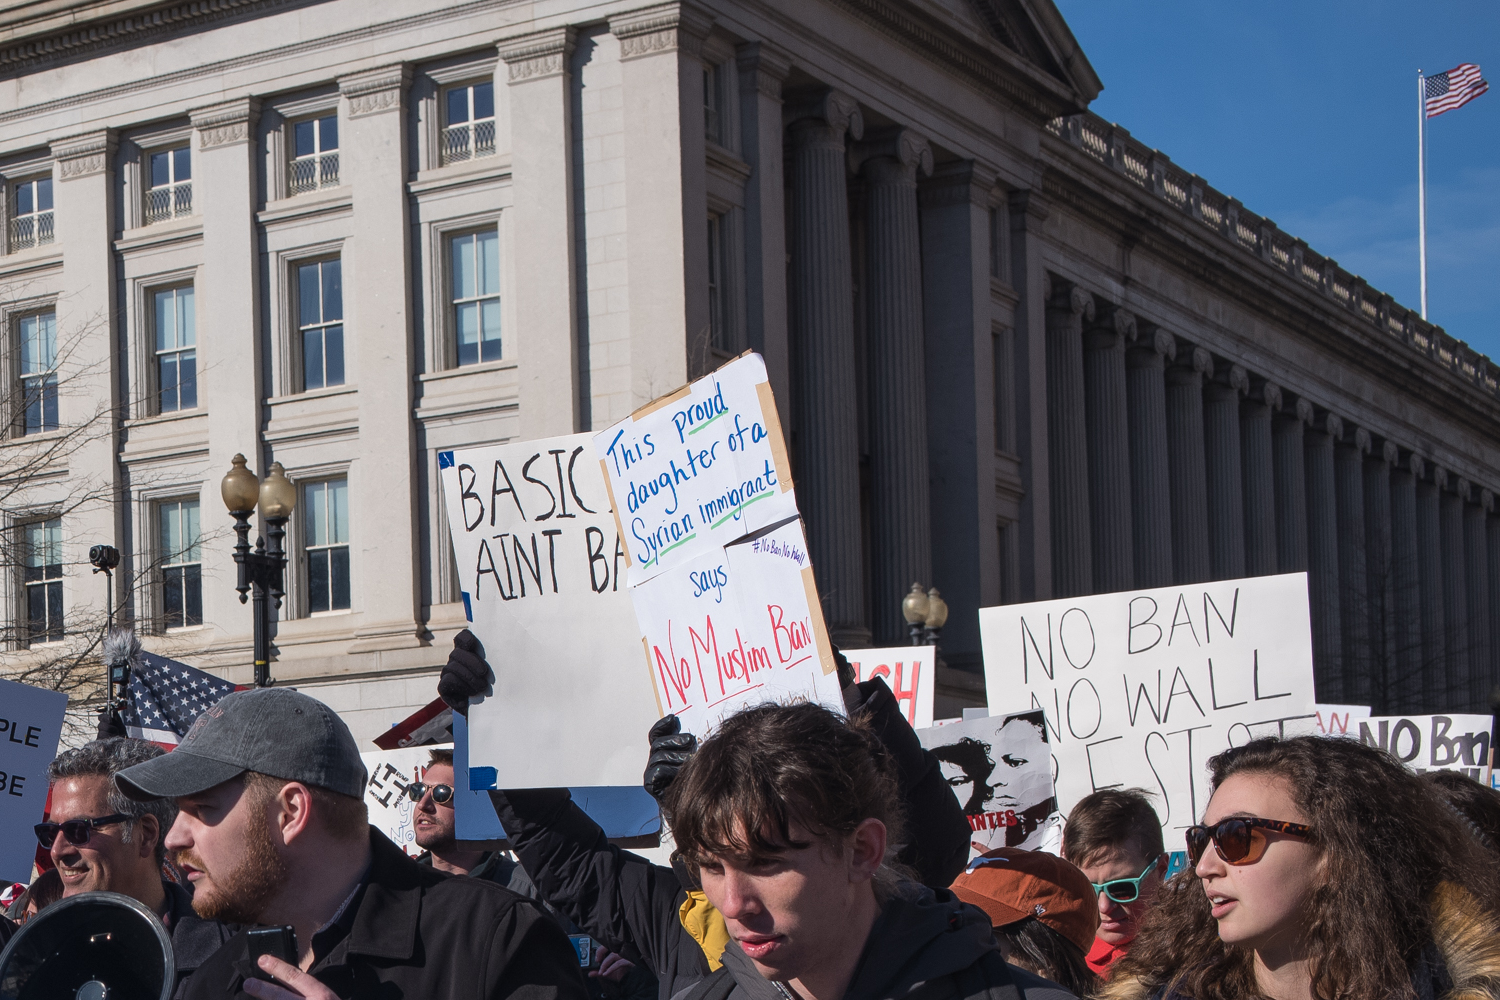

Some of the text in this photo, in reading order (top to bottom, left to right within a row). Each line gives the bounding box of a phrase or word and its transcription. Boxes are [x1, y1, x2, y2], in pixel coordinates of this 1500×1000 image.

[606, 382, 729, 477] This proud
[627, 413, 768, 515] daughter of a
[458, 446, 597, 532] BASIC
[631, 459, 777, 566] Syrian immigrant
[476, 529, 563, 601] AINT
[689, 565, 727, 603] says
[653, 619, 692, 708] No
[688, 614, 772, 703] Muslim
[1021, 588, 1240, 684] NO BAN
[1031, 649, 1292, 744] NO WALL
[1359, 715, 1491, 767] NO Ban
